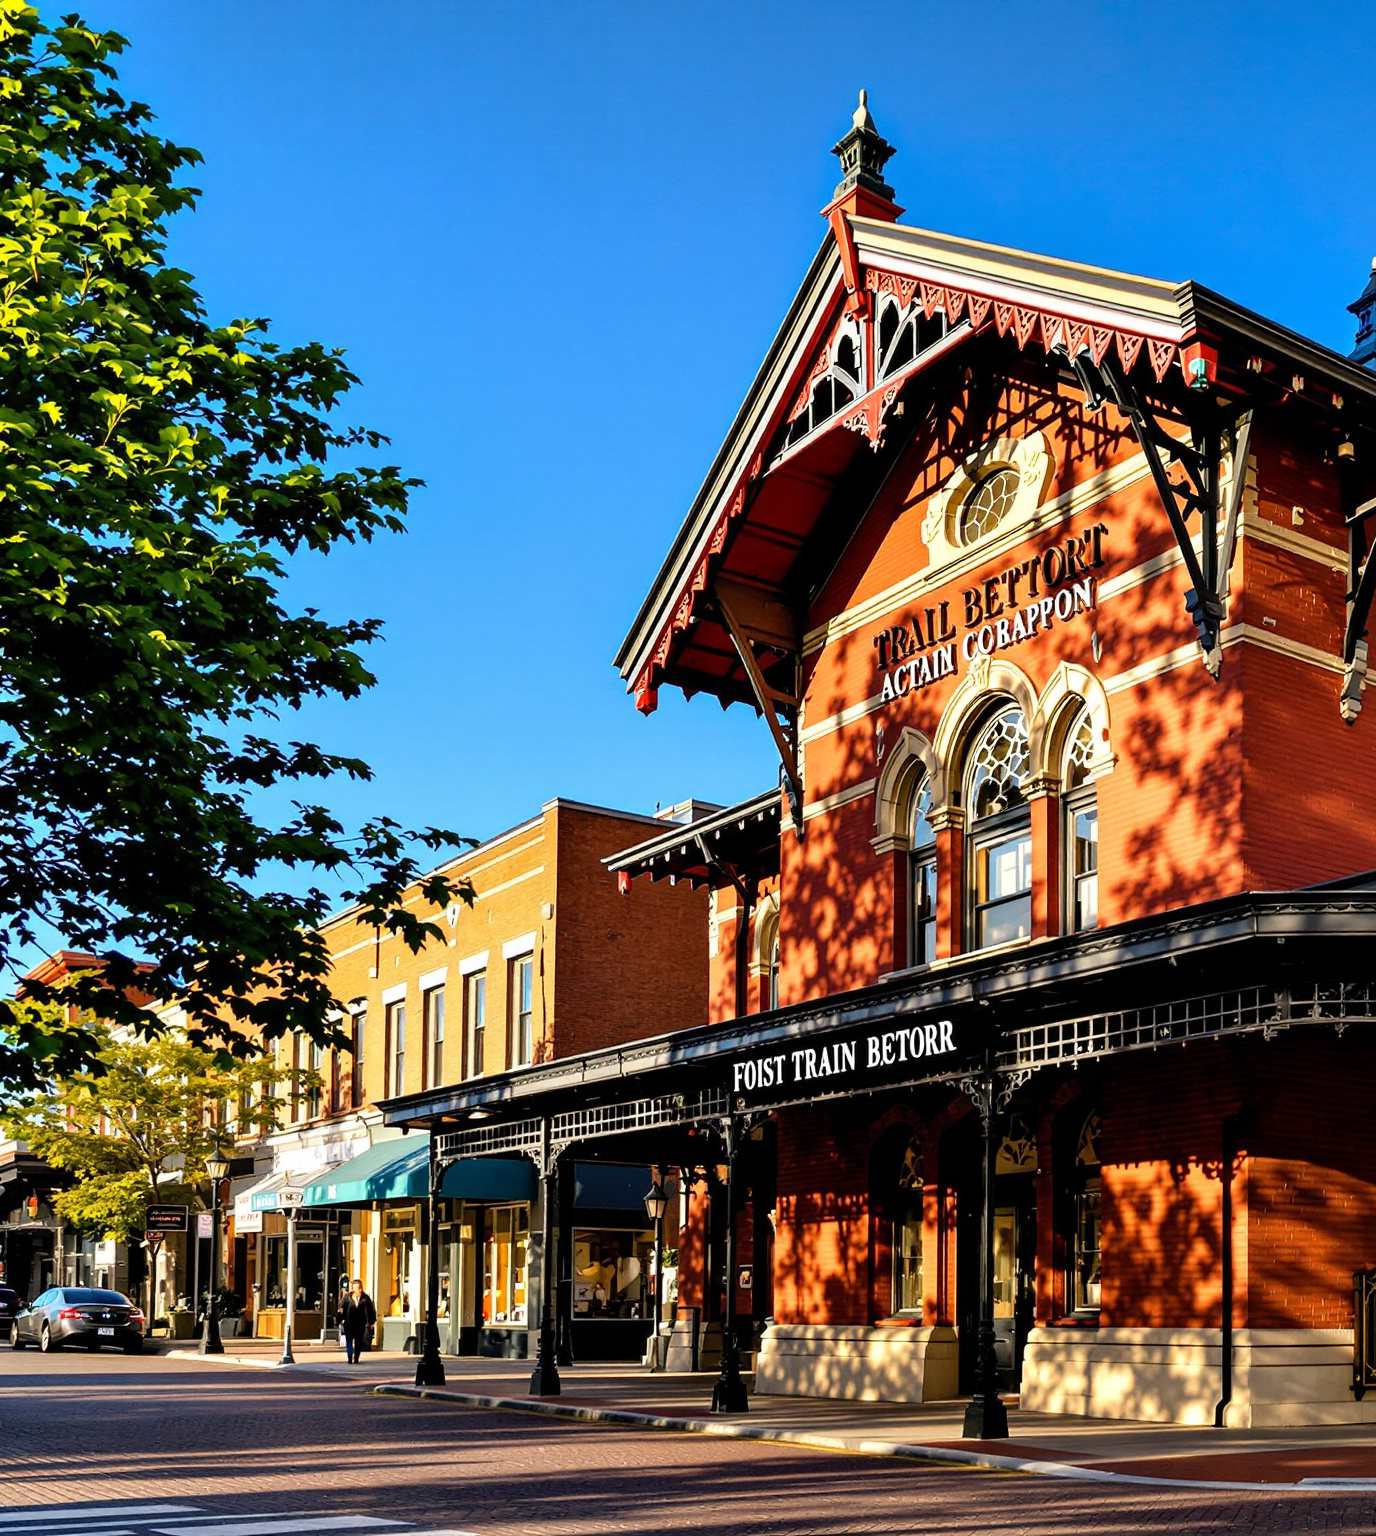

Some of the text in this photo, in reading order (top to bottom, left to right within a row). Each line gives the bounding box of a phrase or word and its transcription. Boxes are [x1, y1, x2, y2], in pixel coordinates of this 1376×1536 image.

[873, 600, 956, 670] TRAIL
[881, 643, 958, 702] ACTAIN
[733, 1055, 785, 1092] FOIST
[791, 1041, 856, 1081] TRAIN
